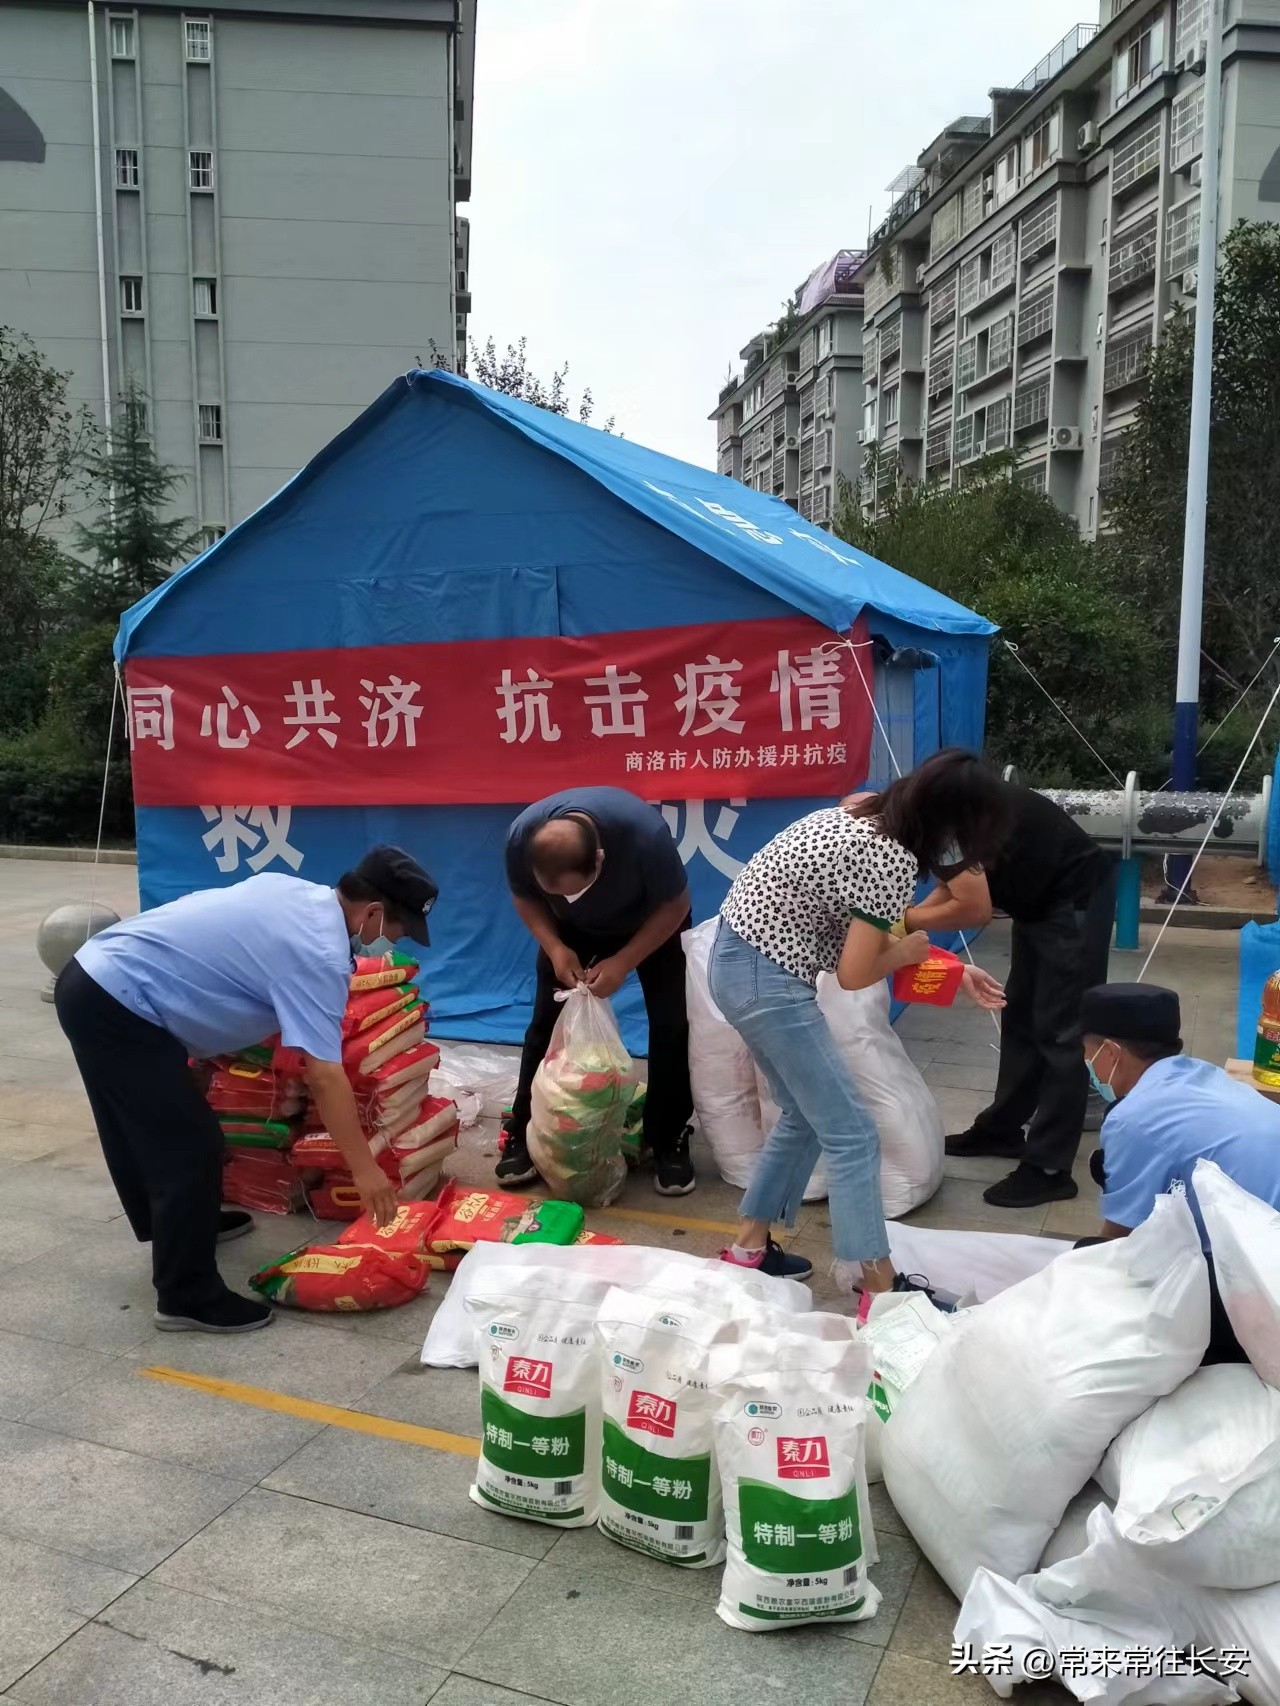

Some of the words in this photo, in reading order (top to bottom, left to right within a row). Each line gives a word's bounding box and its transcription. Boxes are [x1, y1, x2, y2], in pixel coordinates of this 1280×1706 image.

[126, 675, 424, 751] 同心共济
[495, 647, 846, 744] 抗击疫情
[625, 742, 847, 772] 商洛市人防办援丹抗疫
[512, 1360, 549, 1383] 秦力
[486, 1422, 569, 1456] 特制一等粉
[782, 1440, 822, 1462] 秦力
[606, 1455, 692, 1499] 特制一等粉
[753, 1516, 853, 1547] 特制一等粉
